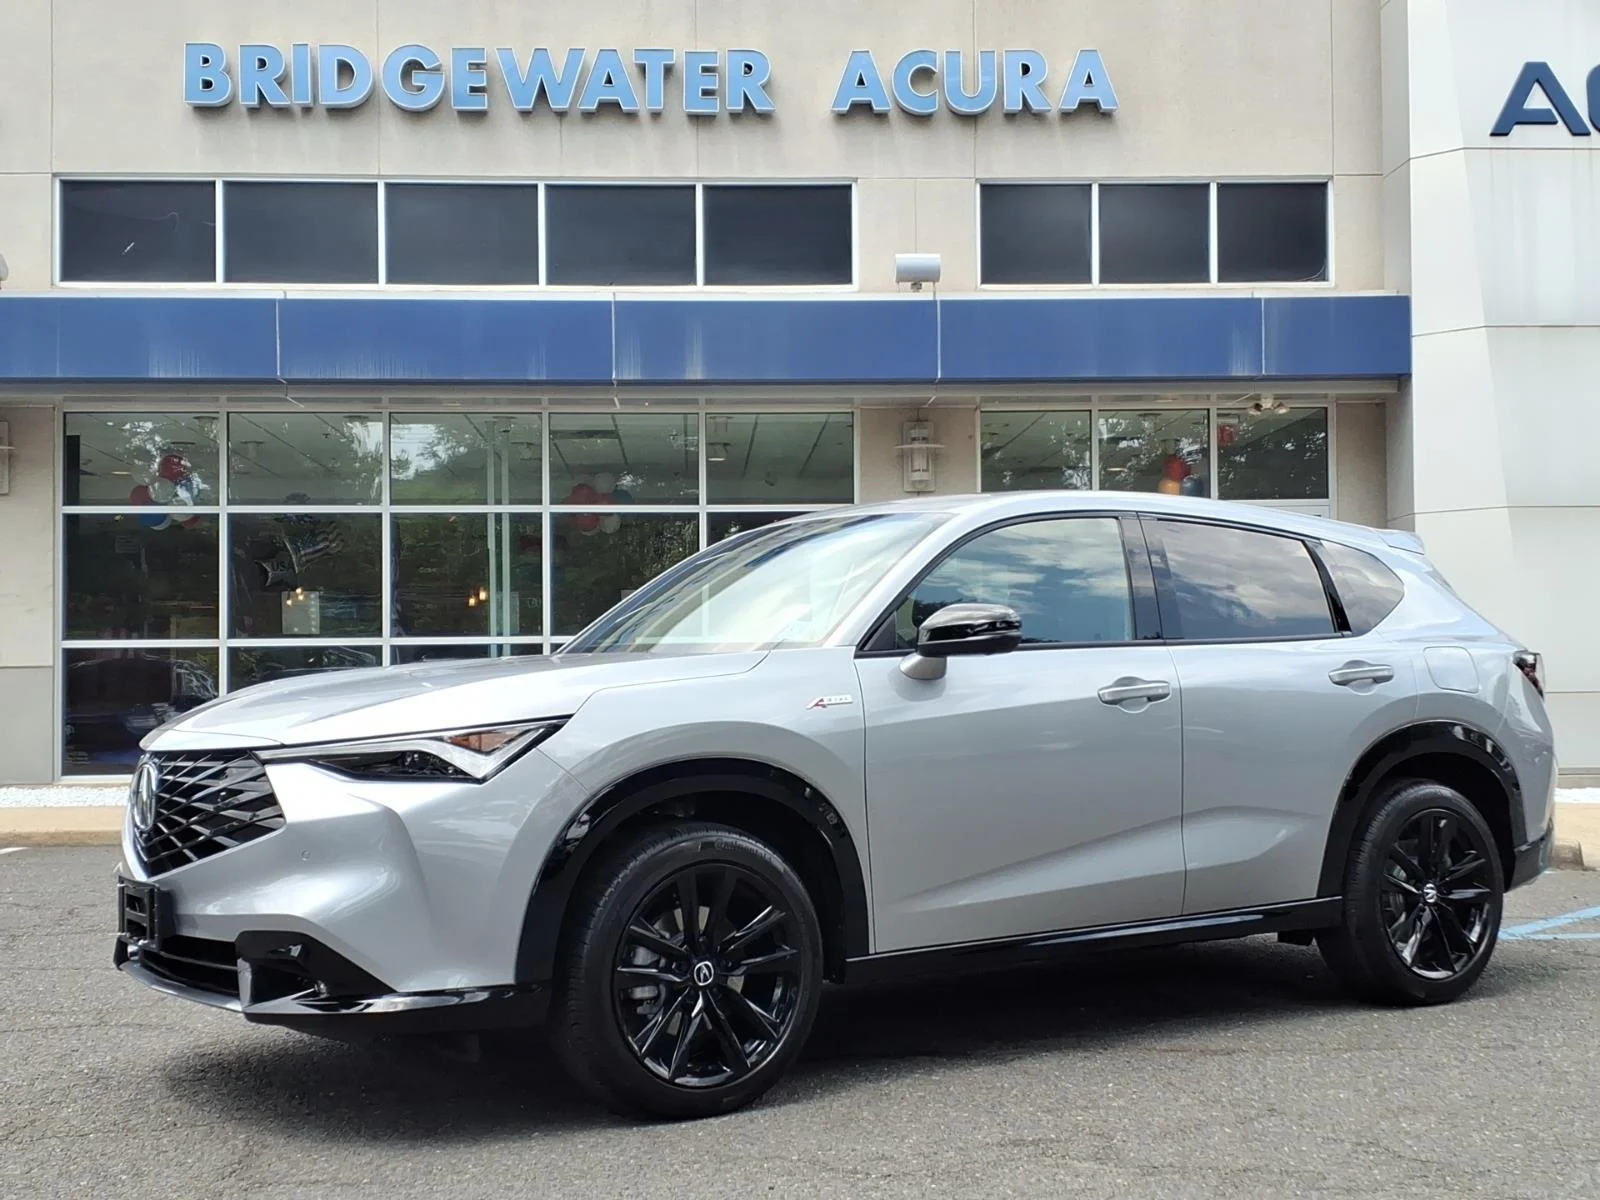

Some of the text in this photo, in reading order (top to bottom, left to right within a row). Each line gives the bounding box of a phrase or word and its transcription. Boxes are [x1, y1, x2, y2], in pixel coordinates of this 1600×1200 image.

[184, 43, 1119, 116] BRIDGEWATER ACURA
[1490, 61, 1600, 137] A
